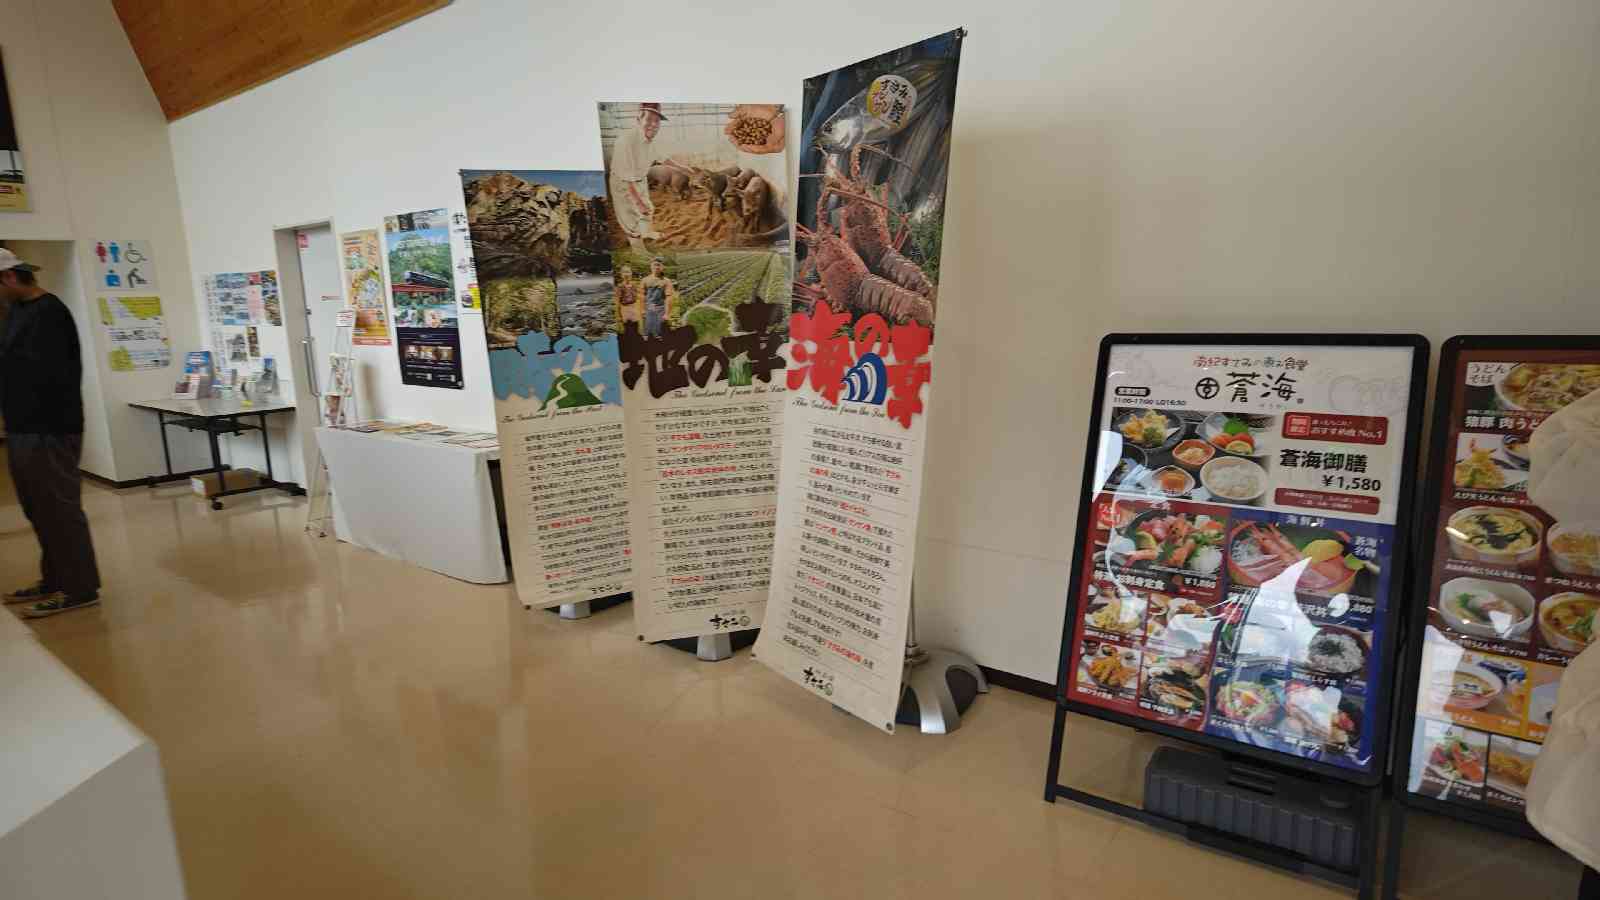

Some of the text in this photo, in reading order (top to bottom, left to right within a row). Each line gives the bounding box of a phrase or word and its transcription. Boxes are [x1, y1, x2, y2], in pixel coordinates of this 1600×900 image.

[1470, 363, 1505, 374] うどん
[1226, 372, 1297, 403] 蒼海
[1469, 375, 1494, 385] そば
[1280, 448, 1368, 473] 蒼海御膳
[1321, 475, 1381, 491] ¥1,580
